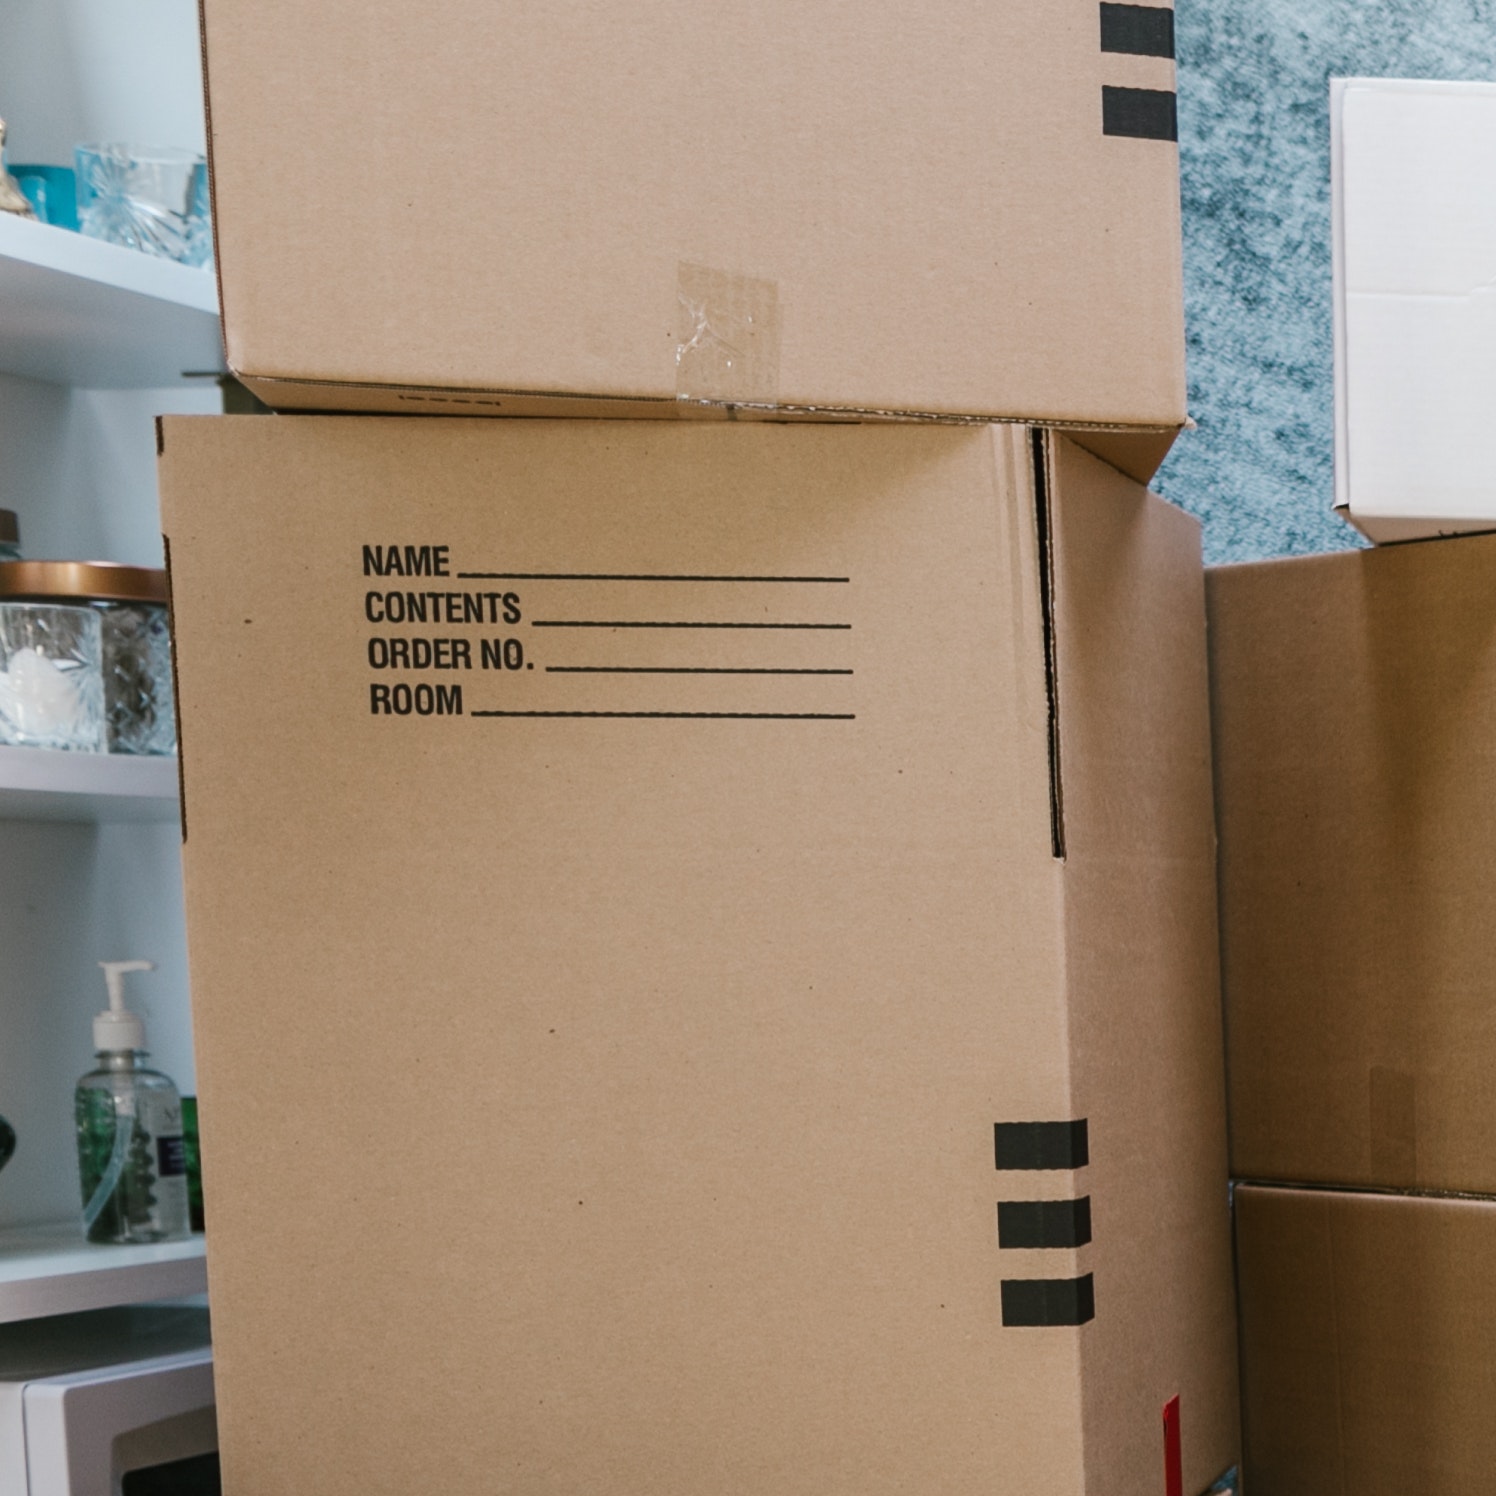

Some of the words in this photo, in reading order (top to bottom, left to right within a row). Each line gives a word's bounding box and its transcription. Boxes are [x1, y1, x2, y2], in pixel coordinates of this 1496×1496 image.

[362, 545, 450, 577] NAME
[365, 591, 522, 624] CONTENTS
[368, 637, 472, 669] ORDER
[480, 638, 534, 670] NO.
[370, 683, 463, 716] ROOM
